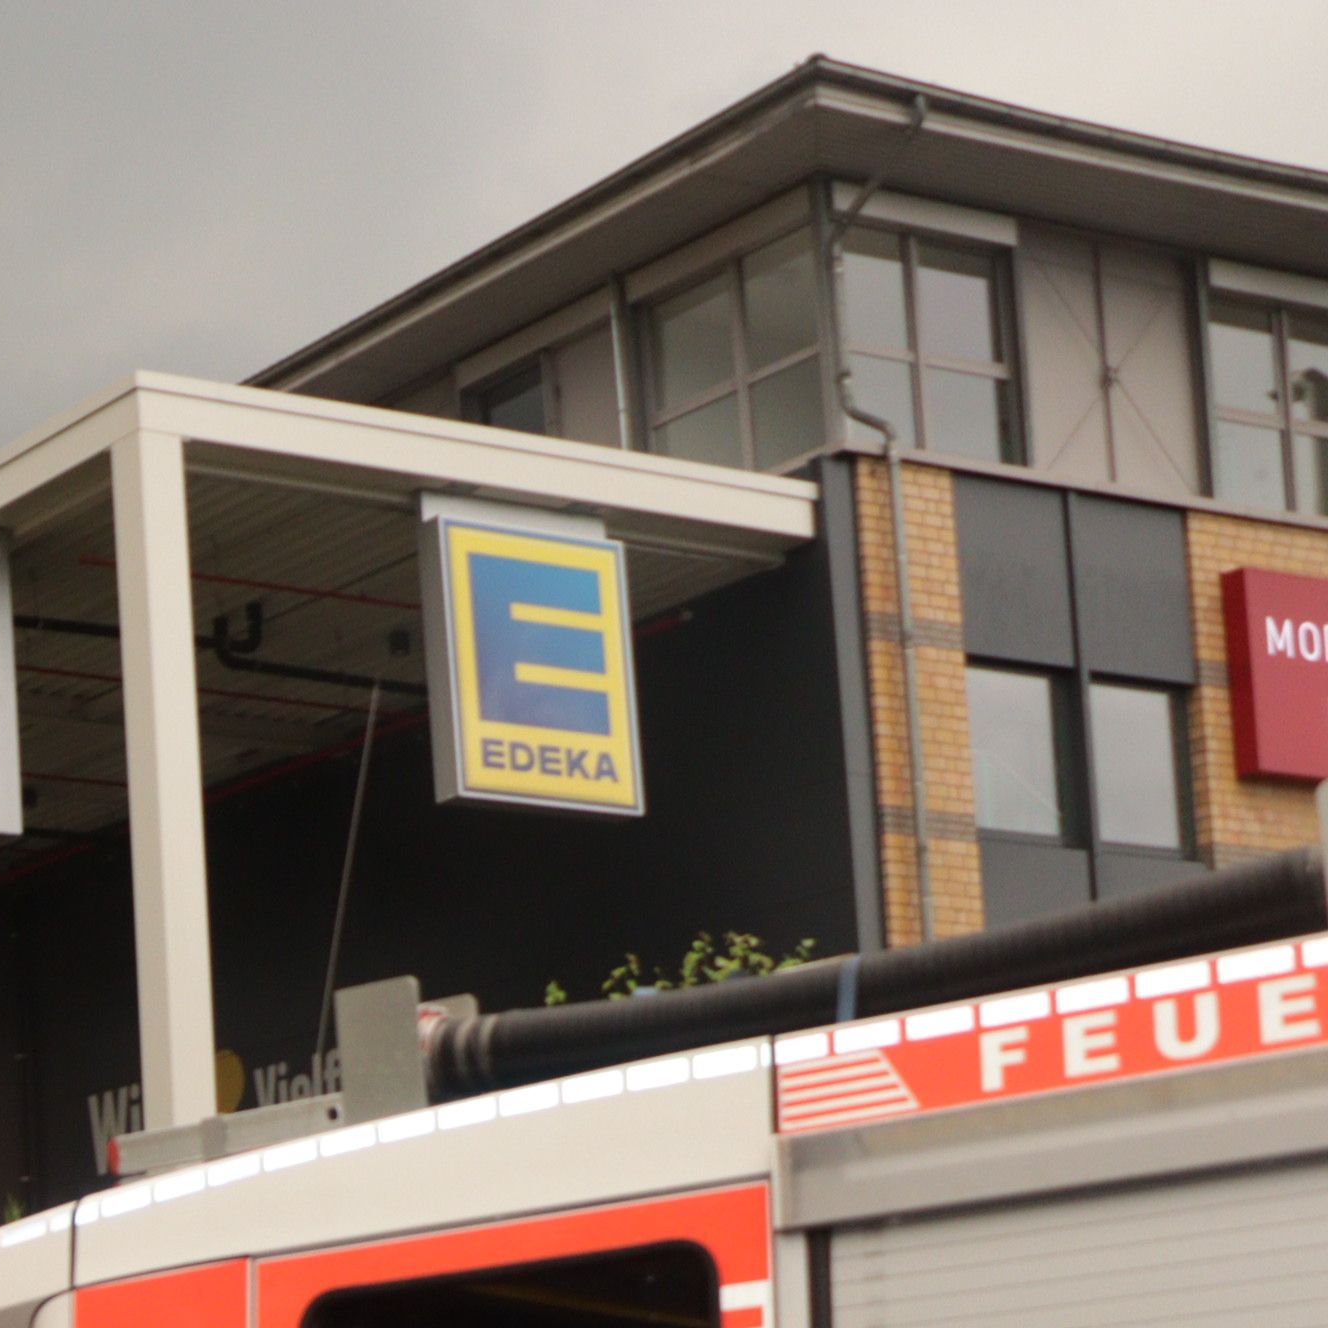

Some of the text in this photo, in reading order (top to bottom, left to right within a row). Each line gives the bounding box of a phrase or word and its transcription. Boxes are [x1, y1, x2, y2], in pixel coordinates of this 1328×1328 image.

[467, 552, 611, 736] E
[1265, 615, 1328, 663] MO
[480, 737, 619, 783] EDEKA
[979, 972, 1321, 1092] FEUE
